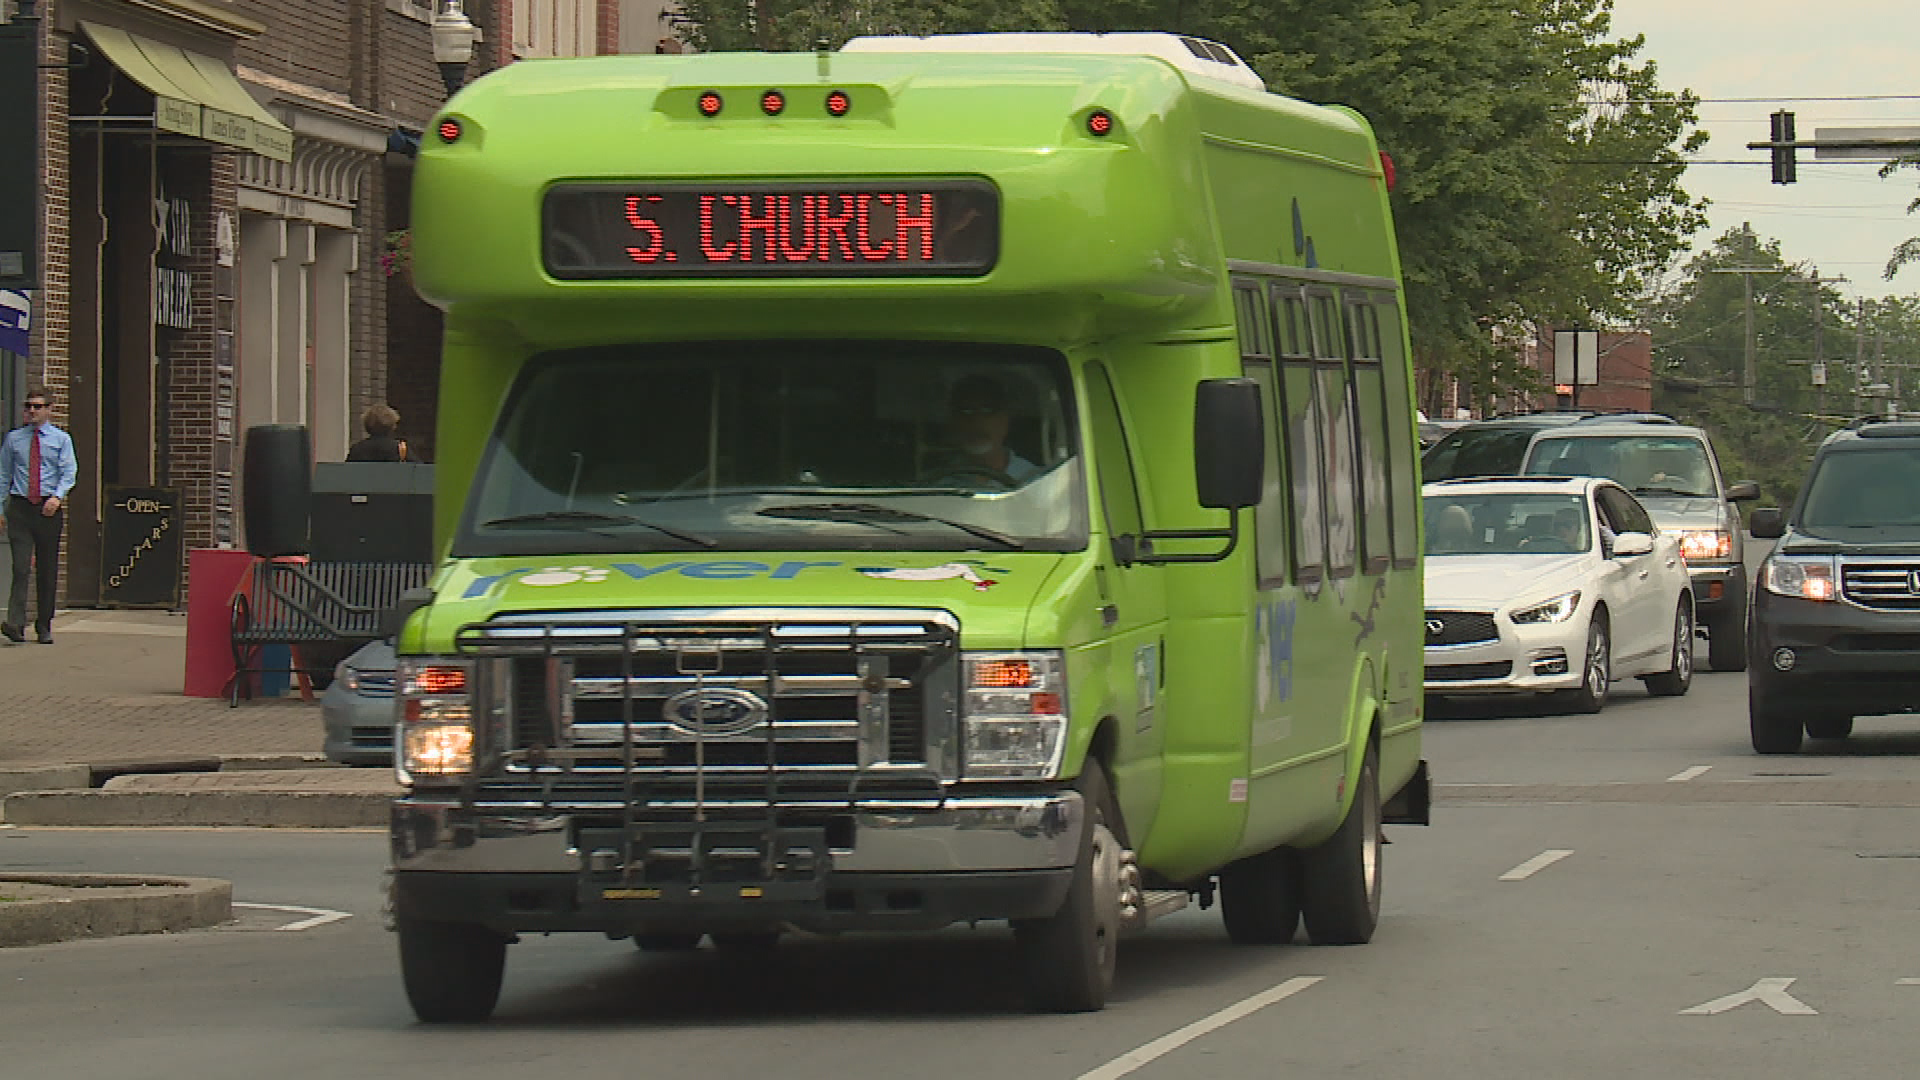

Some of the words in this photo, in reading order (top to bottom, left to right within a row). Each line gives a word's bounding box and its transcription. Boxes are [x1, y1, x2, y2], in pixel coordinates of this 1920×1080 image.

[624, 194, 678, 264] S.
[699, 193, 934, 262] CHURCH
[126, 497, 160, 513] OPEN
[109, 517, 169, 587] GUITARS
